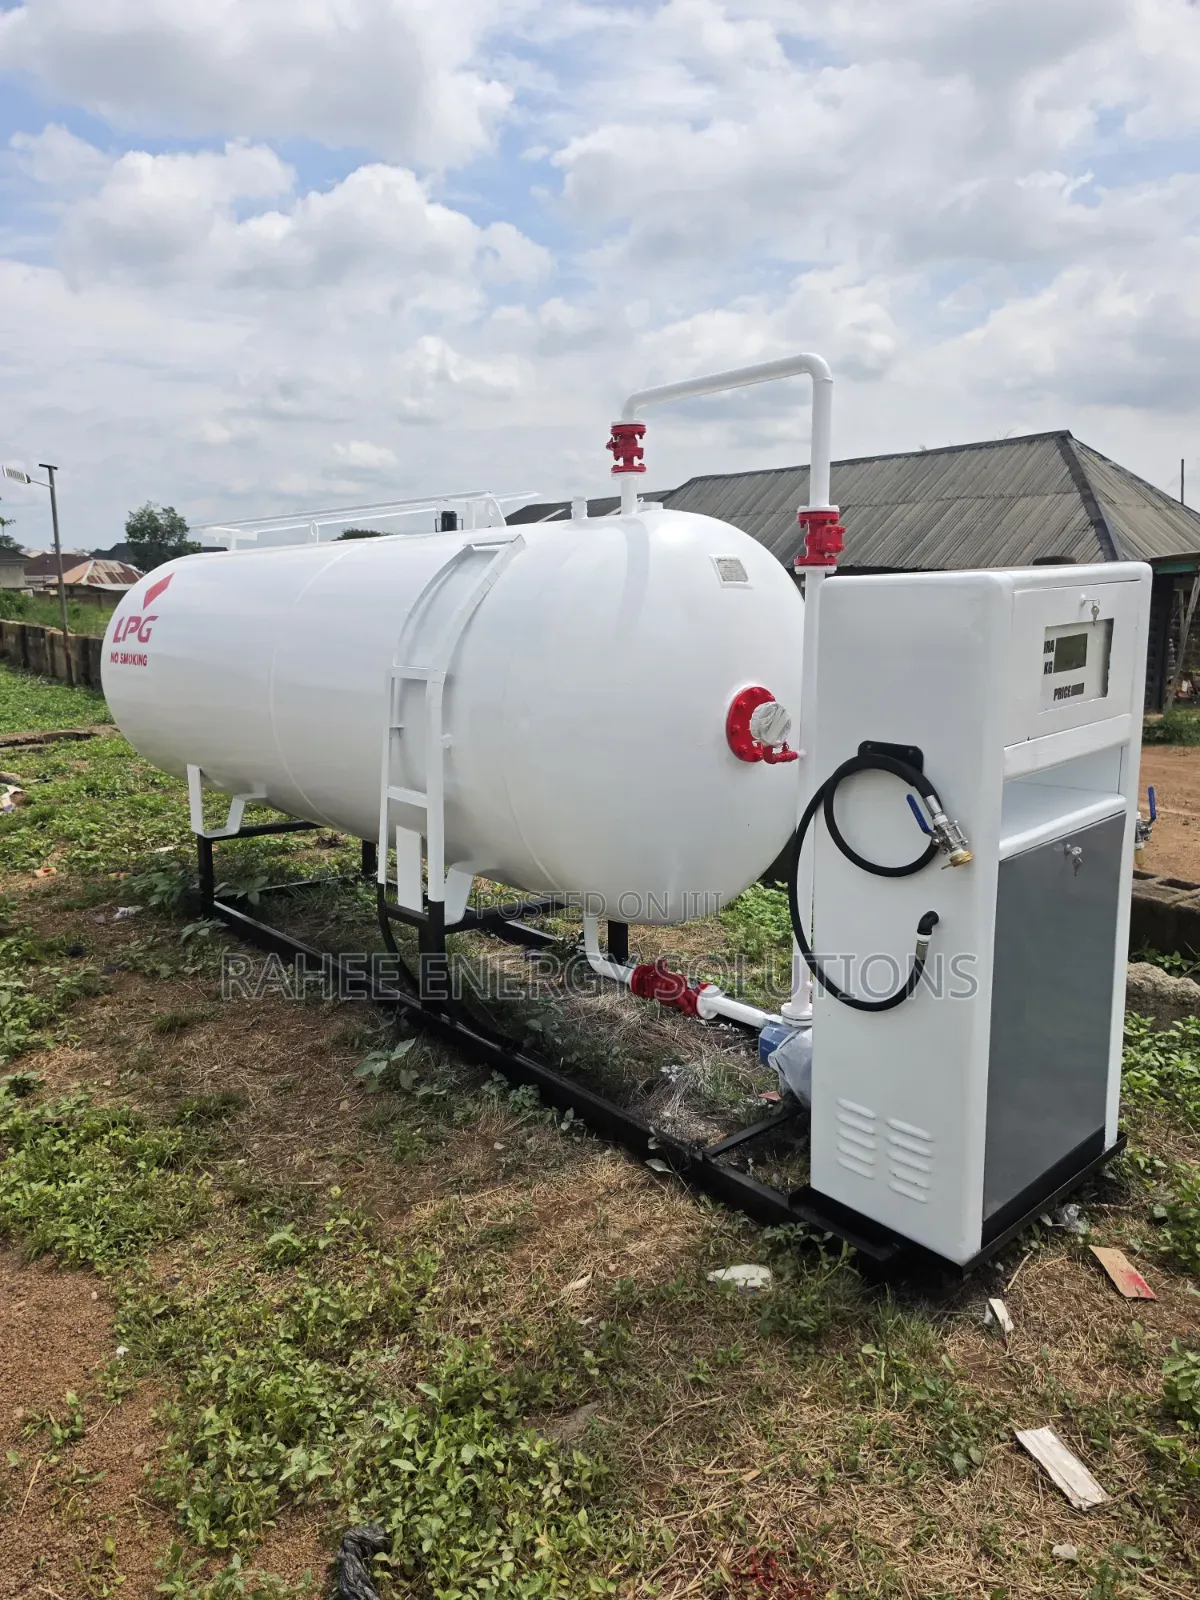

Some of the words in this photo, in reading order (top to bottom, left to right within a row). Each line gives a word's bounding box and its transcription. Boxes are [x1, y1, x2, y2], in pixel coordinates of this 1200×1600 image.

[113, 615, 159, 643] LPG
[110, 652, 119, 663] NO
[120, 653, 148, 667] SMOKING
[1043, 661, 1053, 675] KG
[1053, 685, 1072, 701] PRICE
